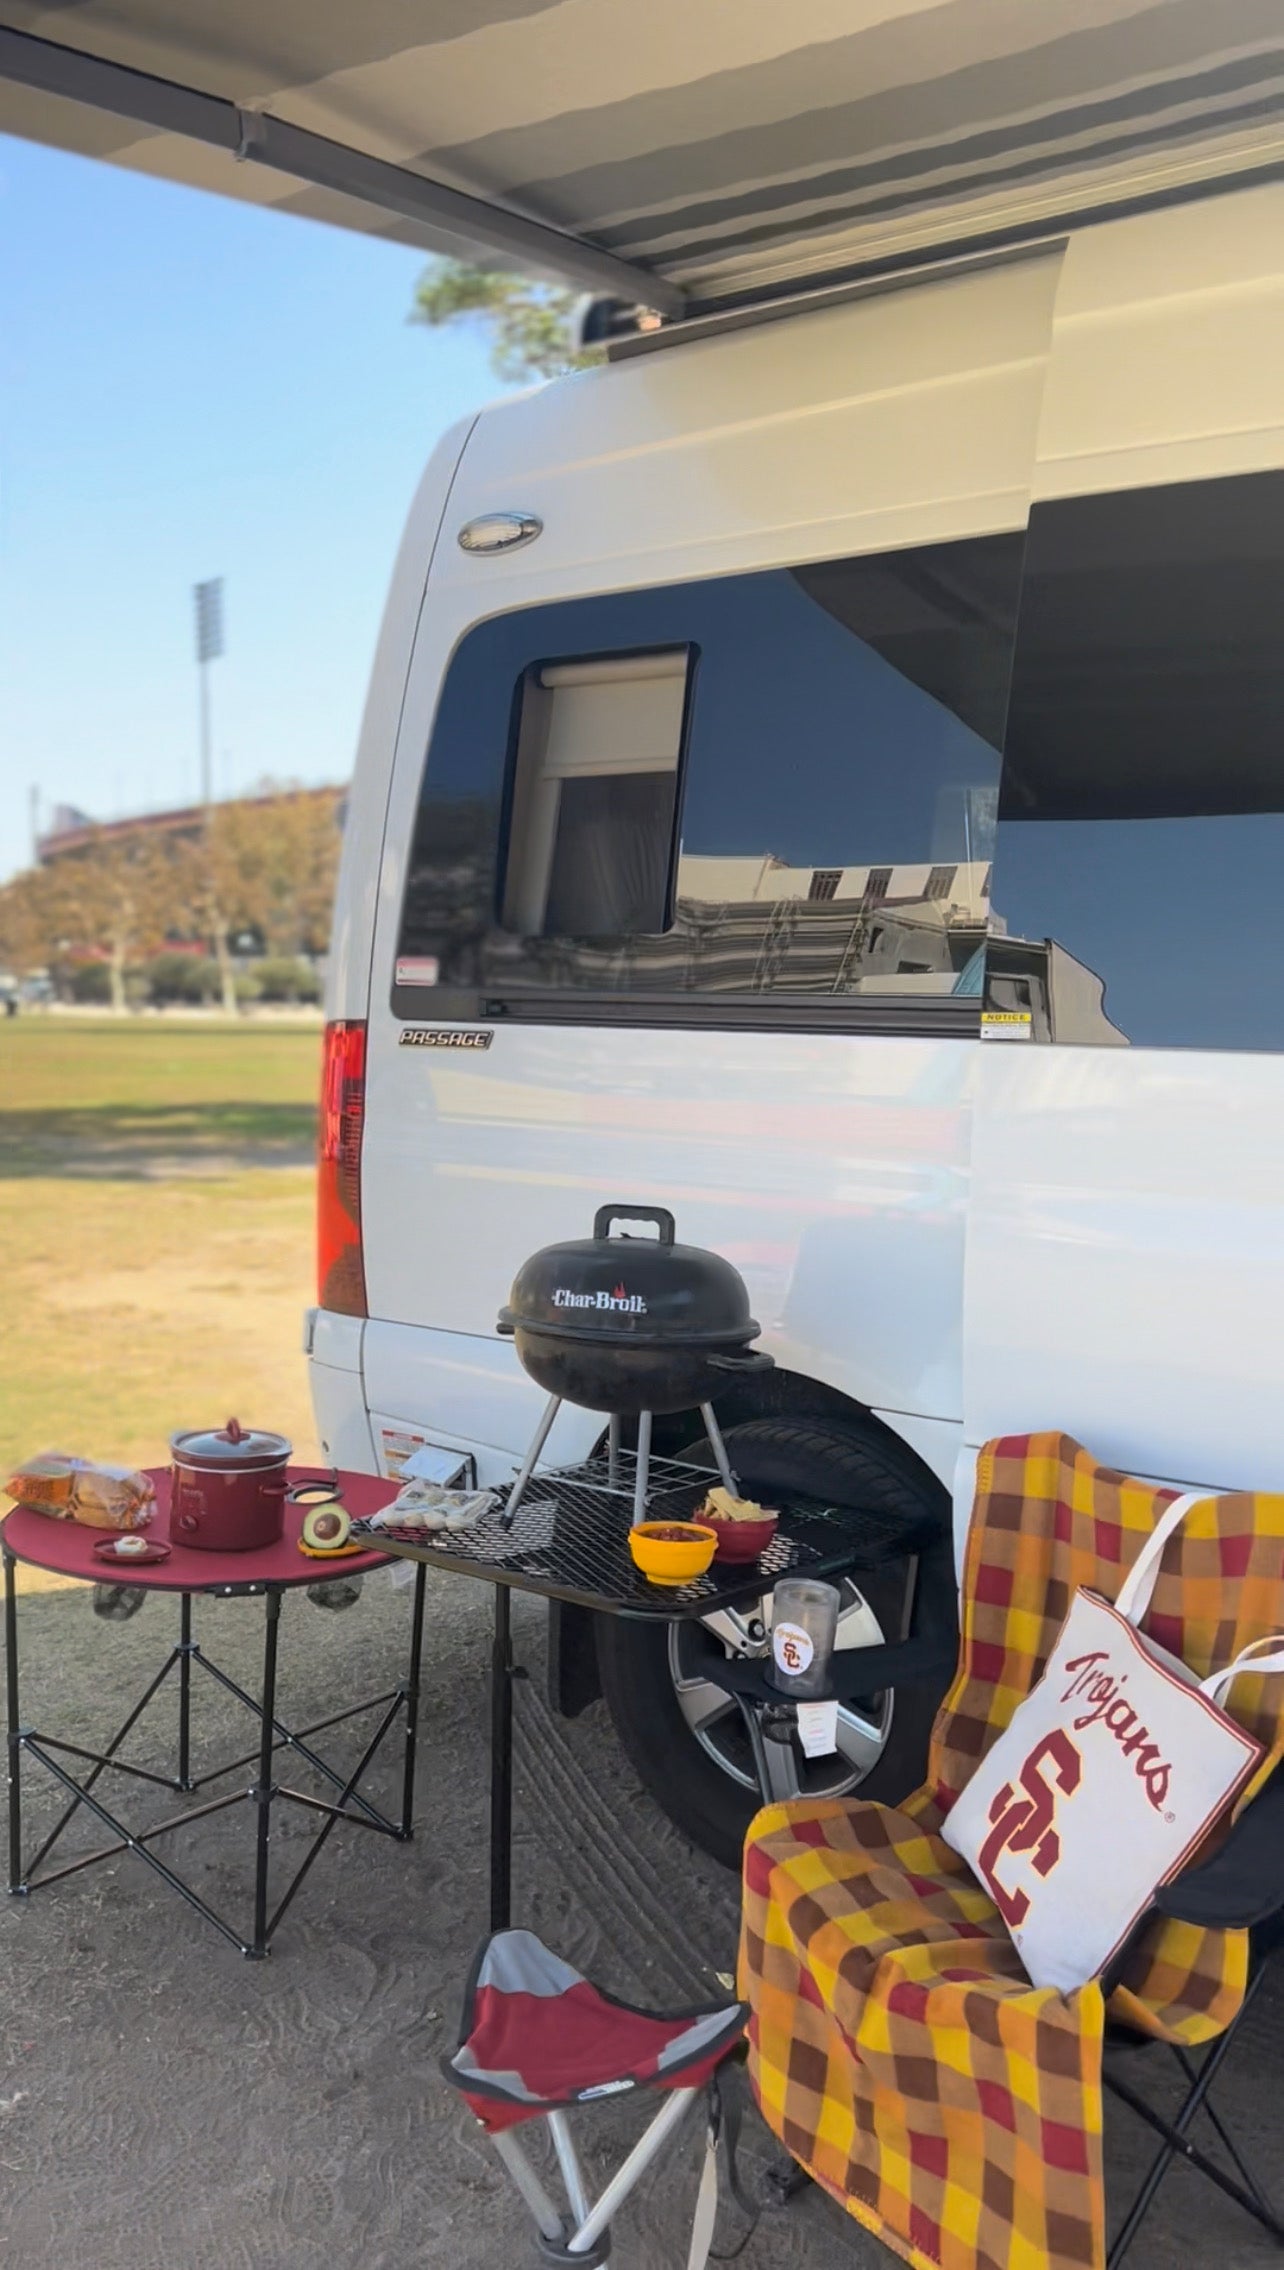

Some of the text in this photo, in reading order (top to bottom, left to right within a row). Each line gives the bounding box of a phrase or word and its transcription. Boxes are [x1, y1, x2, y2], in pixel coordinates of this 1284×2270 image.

[400, 1030, 489, 1047] PASSAGE
[552, 1289, 646, 1313] Char-Broil
[1061, 1652, 1173, 1813] Trojans
[978, 1727, 1083, 1930] SC
